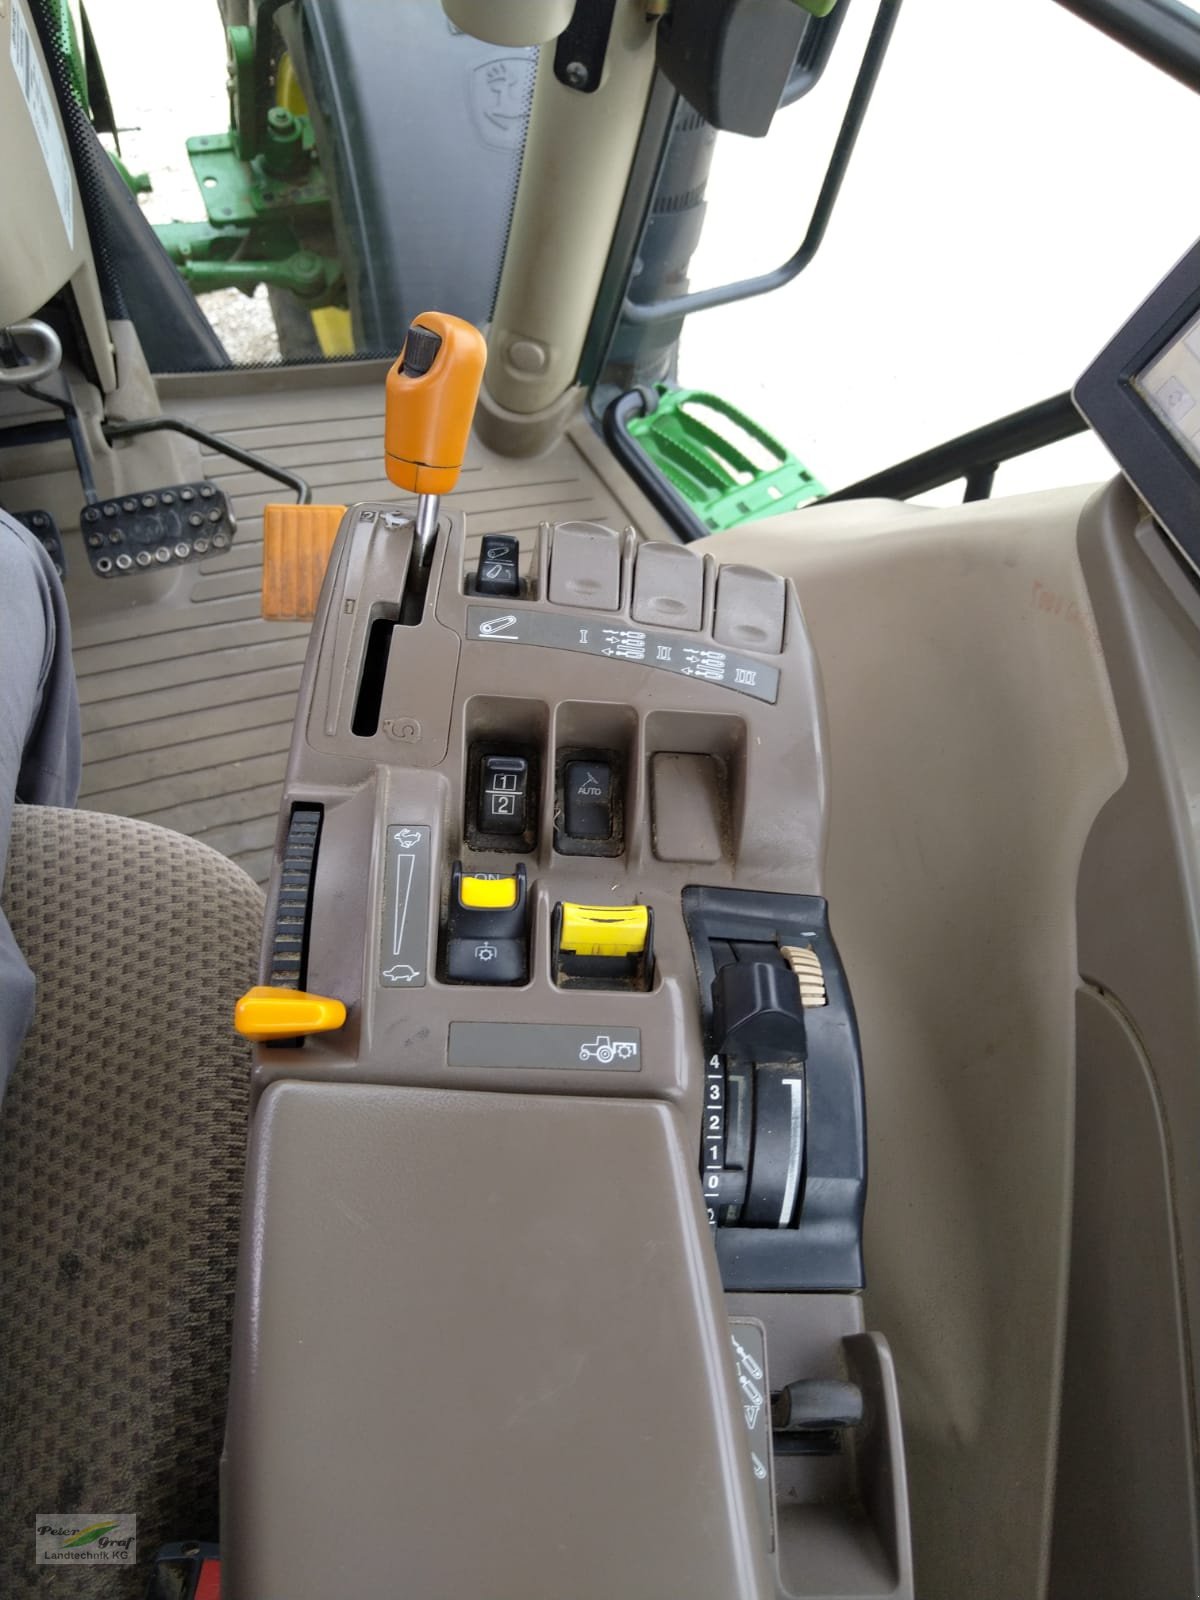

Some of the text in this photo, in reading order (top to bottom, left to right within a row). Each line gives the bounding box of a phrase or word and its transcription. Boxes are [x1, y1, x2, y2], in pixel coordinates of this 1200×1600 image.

[500, 775, 508, 789] 1
[577, 786, 602, 796] AUTO
[497, 796, 509, 814] 2
[709, 1054, 720, 1069] 4
[709, 1084, 721, 1100] 3
[709, 1115, 720, 1131] 2
[709, 1145, 718, 1161] 1
[708, 1175, 719, 1189] 0
